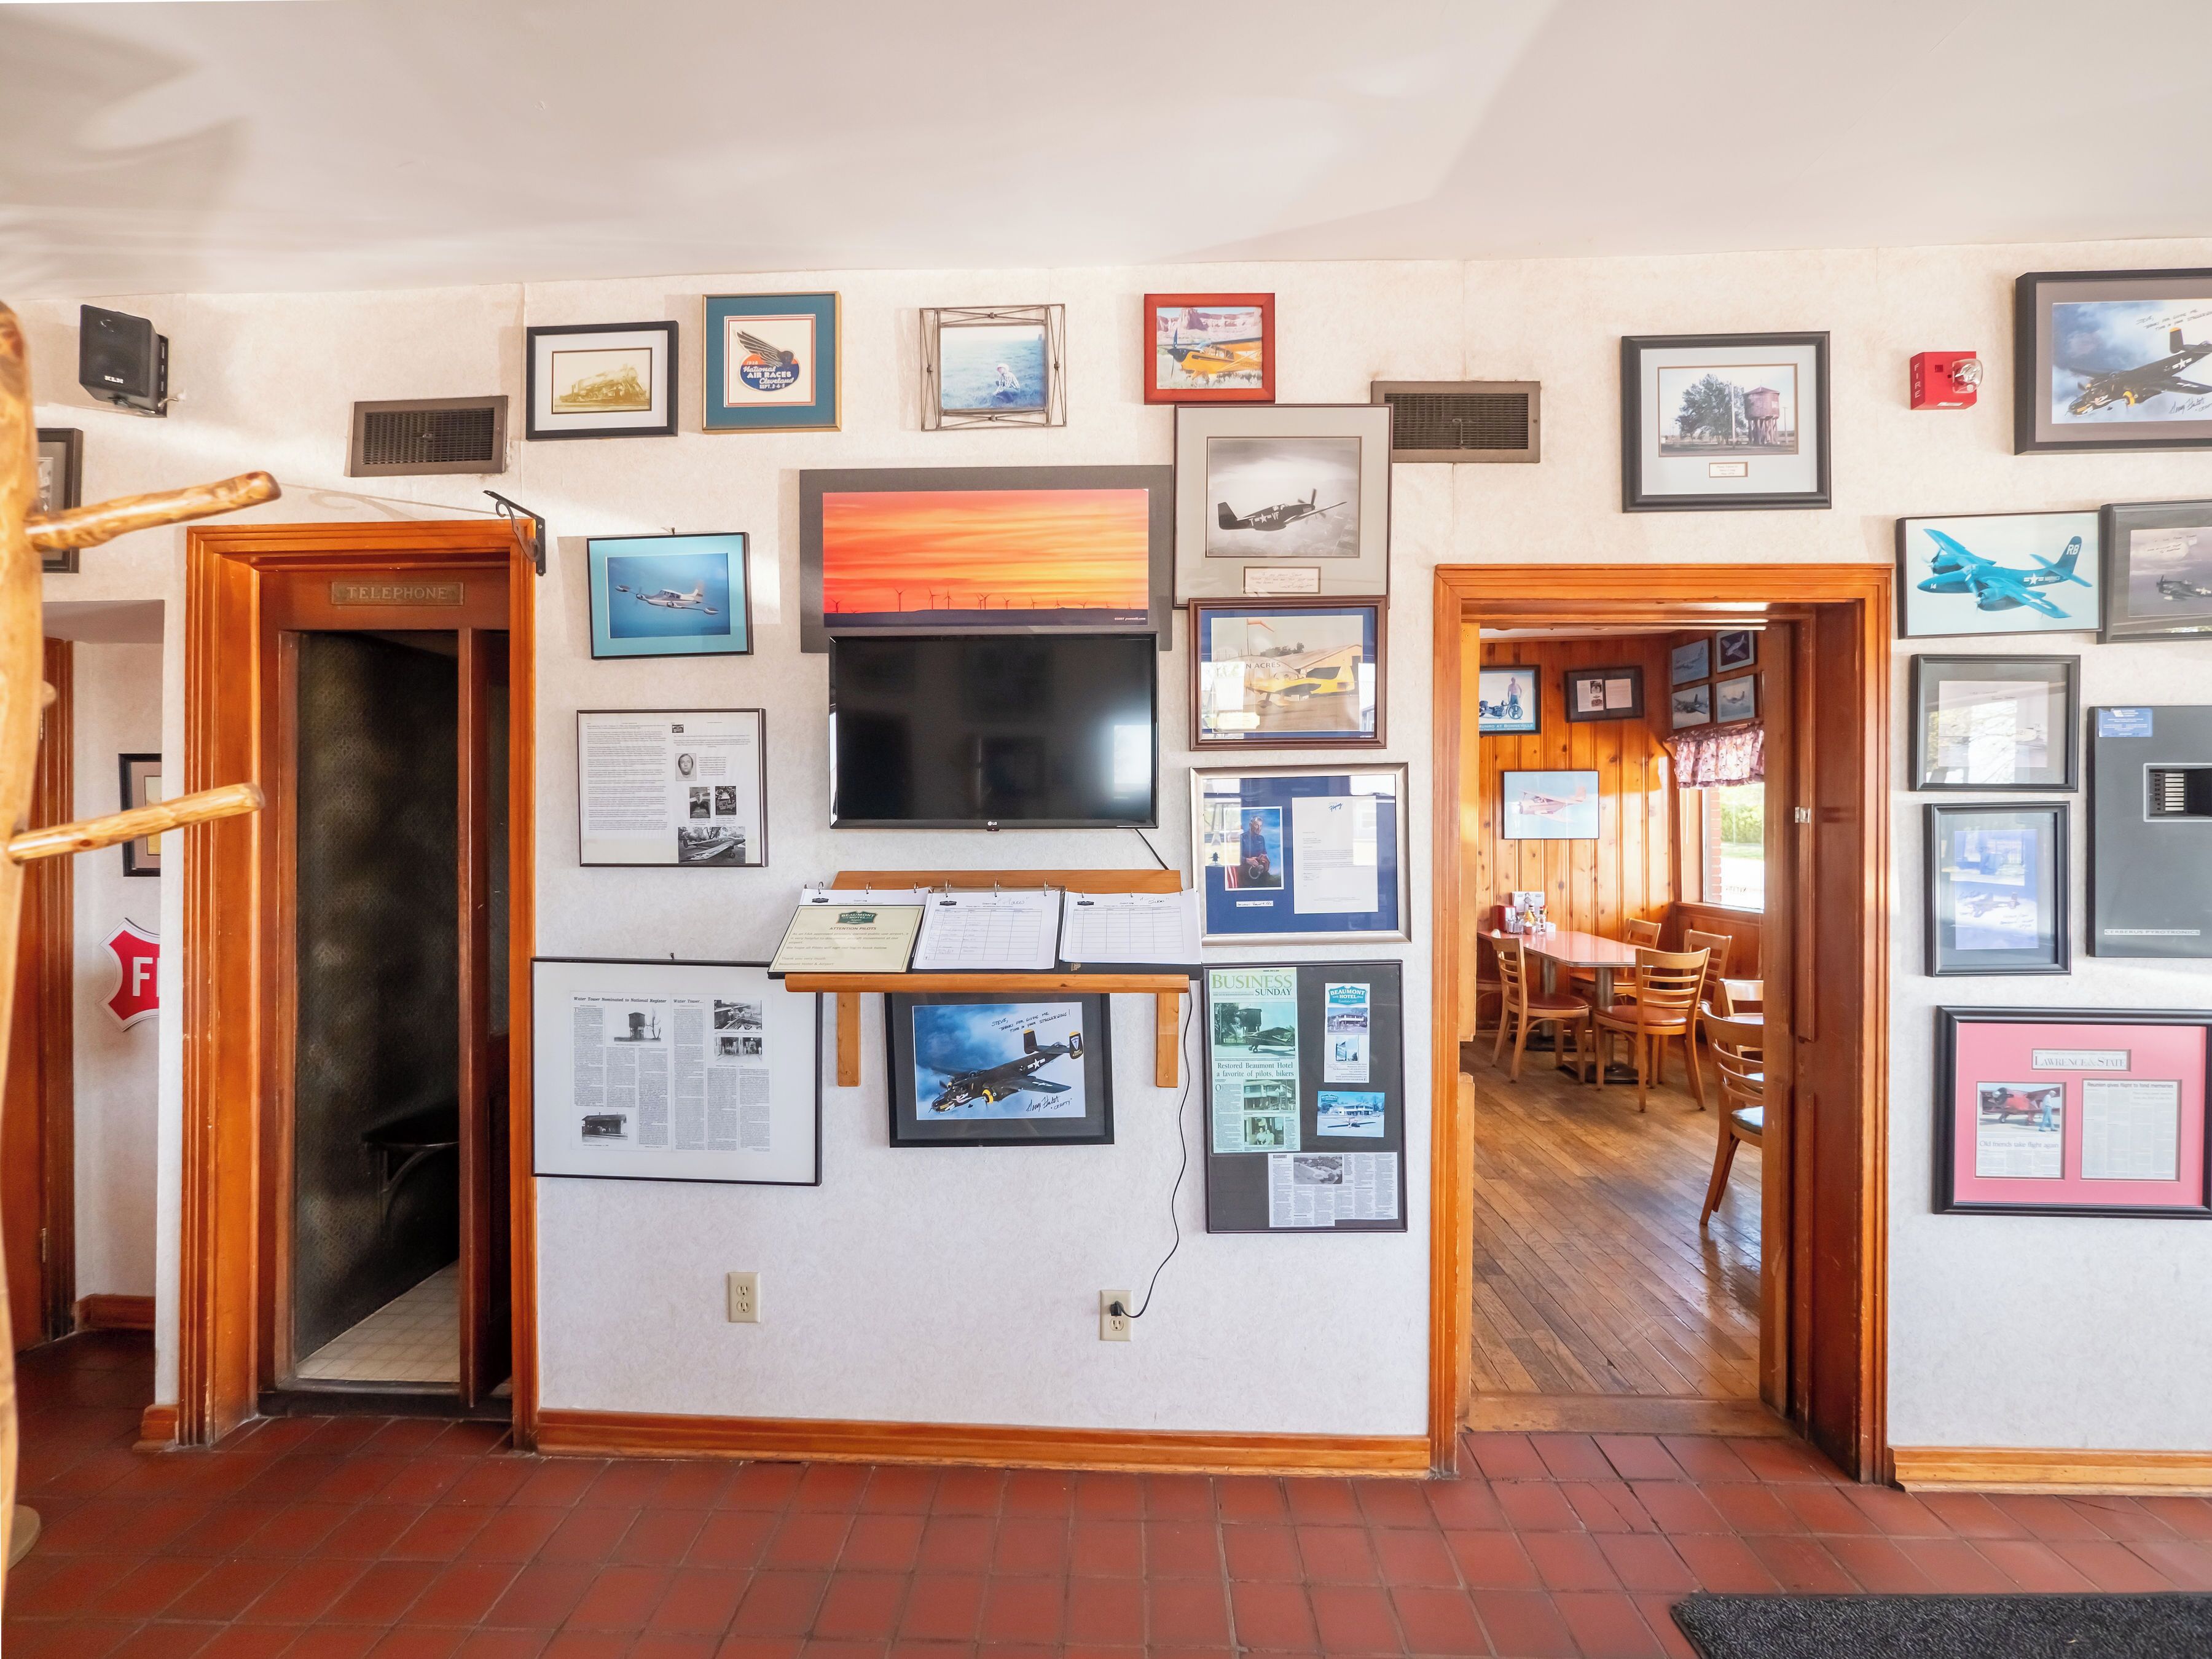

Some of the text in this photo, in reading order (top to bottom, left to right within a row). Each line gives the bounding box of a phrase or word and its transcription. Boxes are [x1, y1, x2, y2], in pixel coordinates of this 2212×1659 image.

[1249, 518, 1253, 527] T
[2066, 544, 2079, 555] RB
[347, 587, 447, 600] TELEPHONE
[1212, 975, 1293, 989] BUSINESS
[992, 1018, 1008, 1027] STEVE,
[2034, 1056, 2086, 1066] LAWRENCE
[2097, 1057, 2125, 1067] STATE
